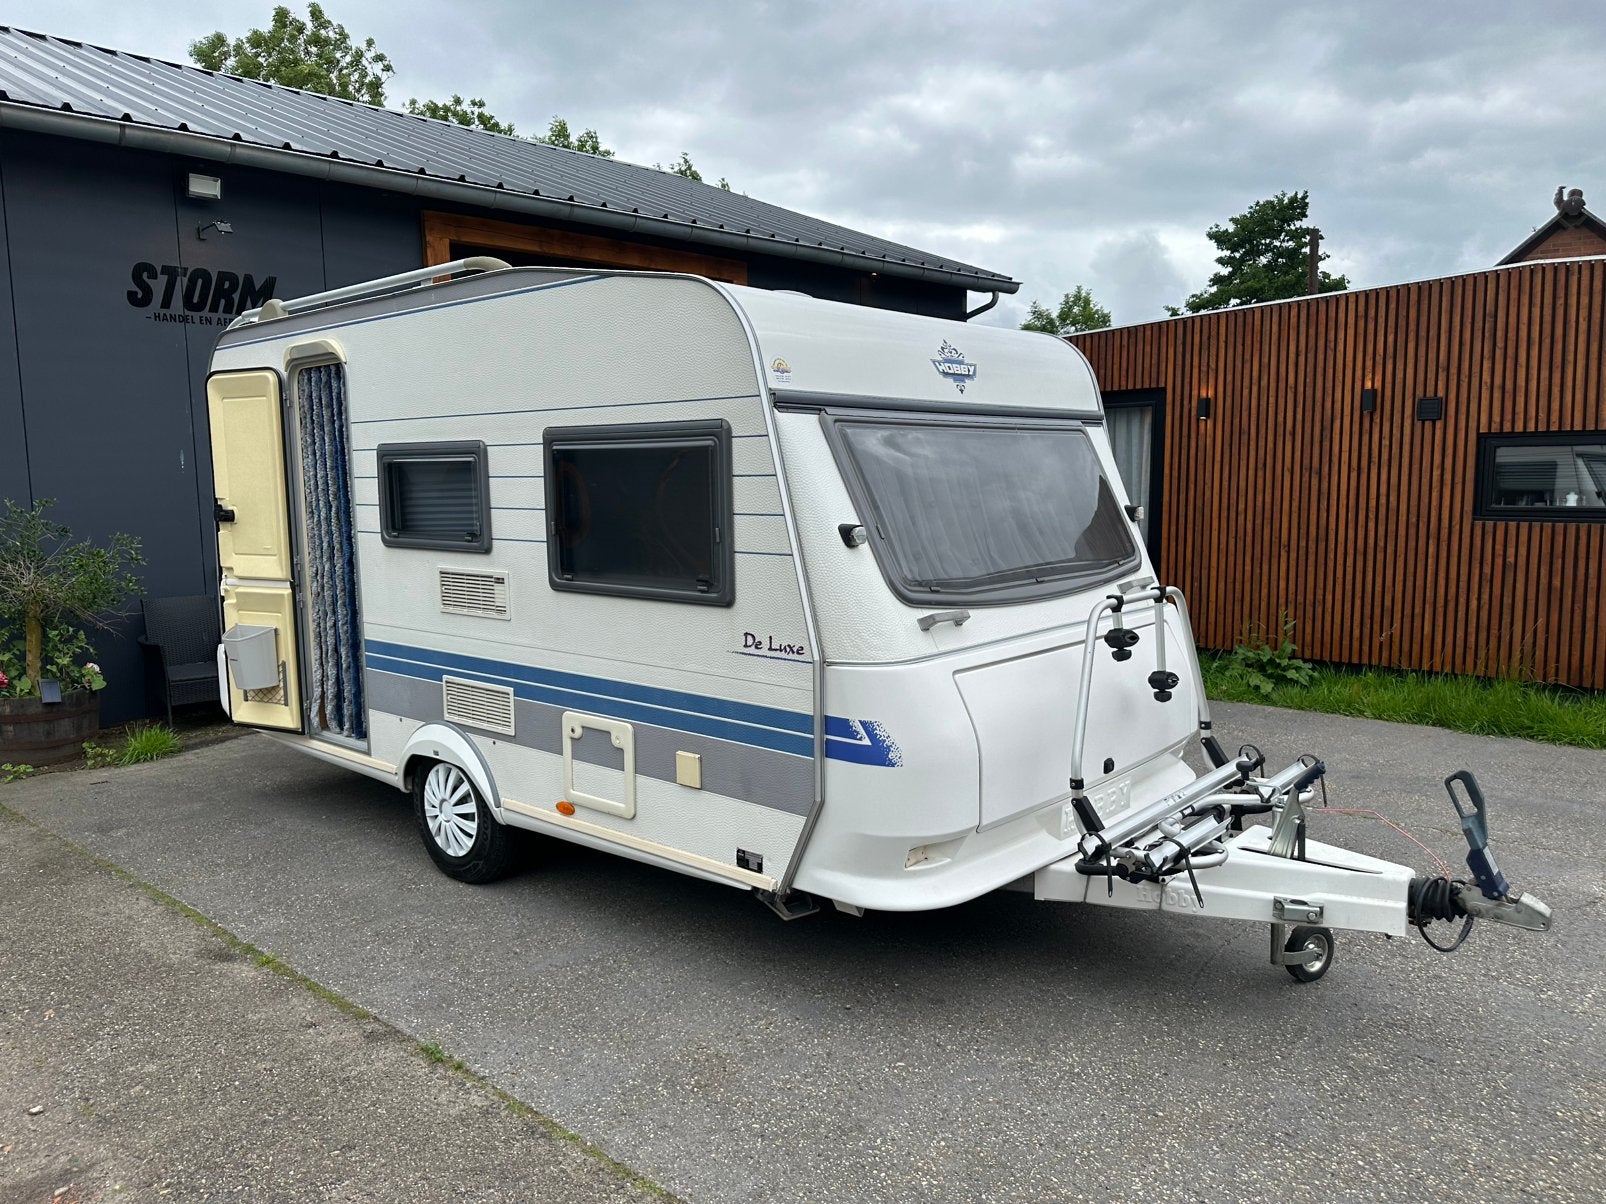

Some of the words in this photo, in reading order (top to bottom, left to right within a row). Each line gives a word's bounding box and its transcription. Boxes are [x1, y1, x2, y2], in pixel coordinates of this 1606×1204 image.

[127, 262, 277, 315] STORM
[200, 315, 213, 326] EN
[935, 361, 975, 375] HOBBY
[743, 632, 763, 650] De
[768, 636, 805, 656] Luxe
